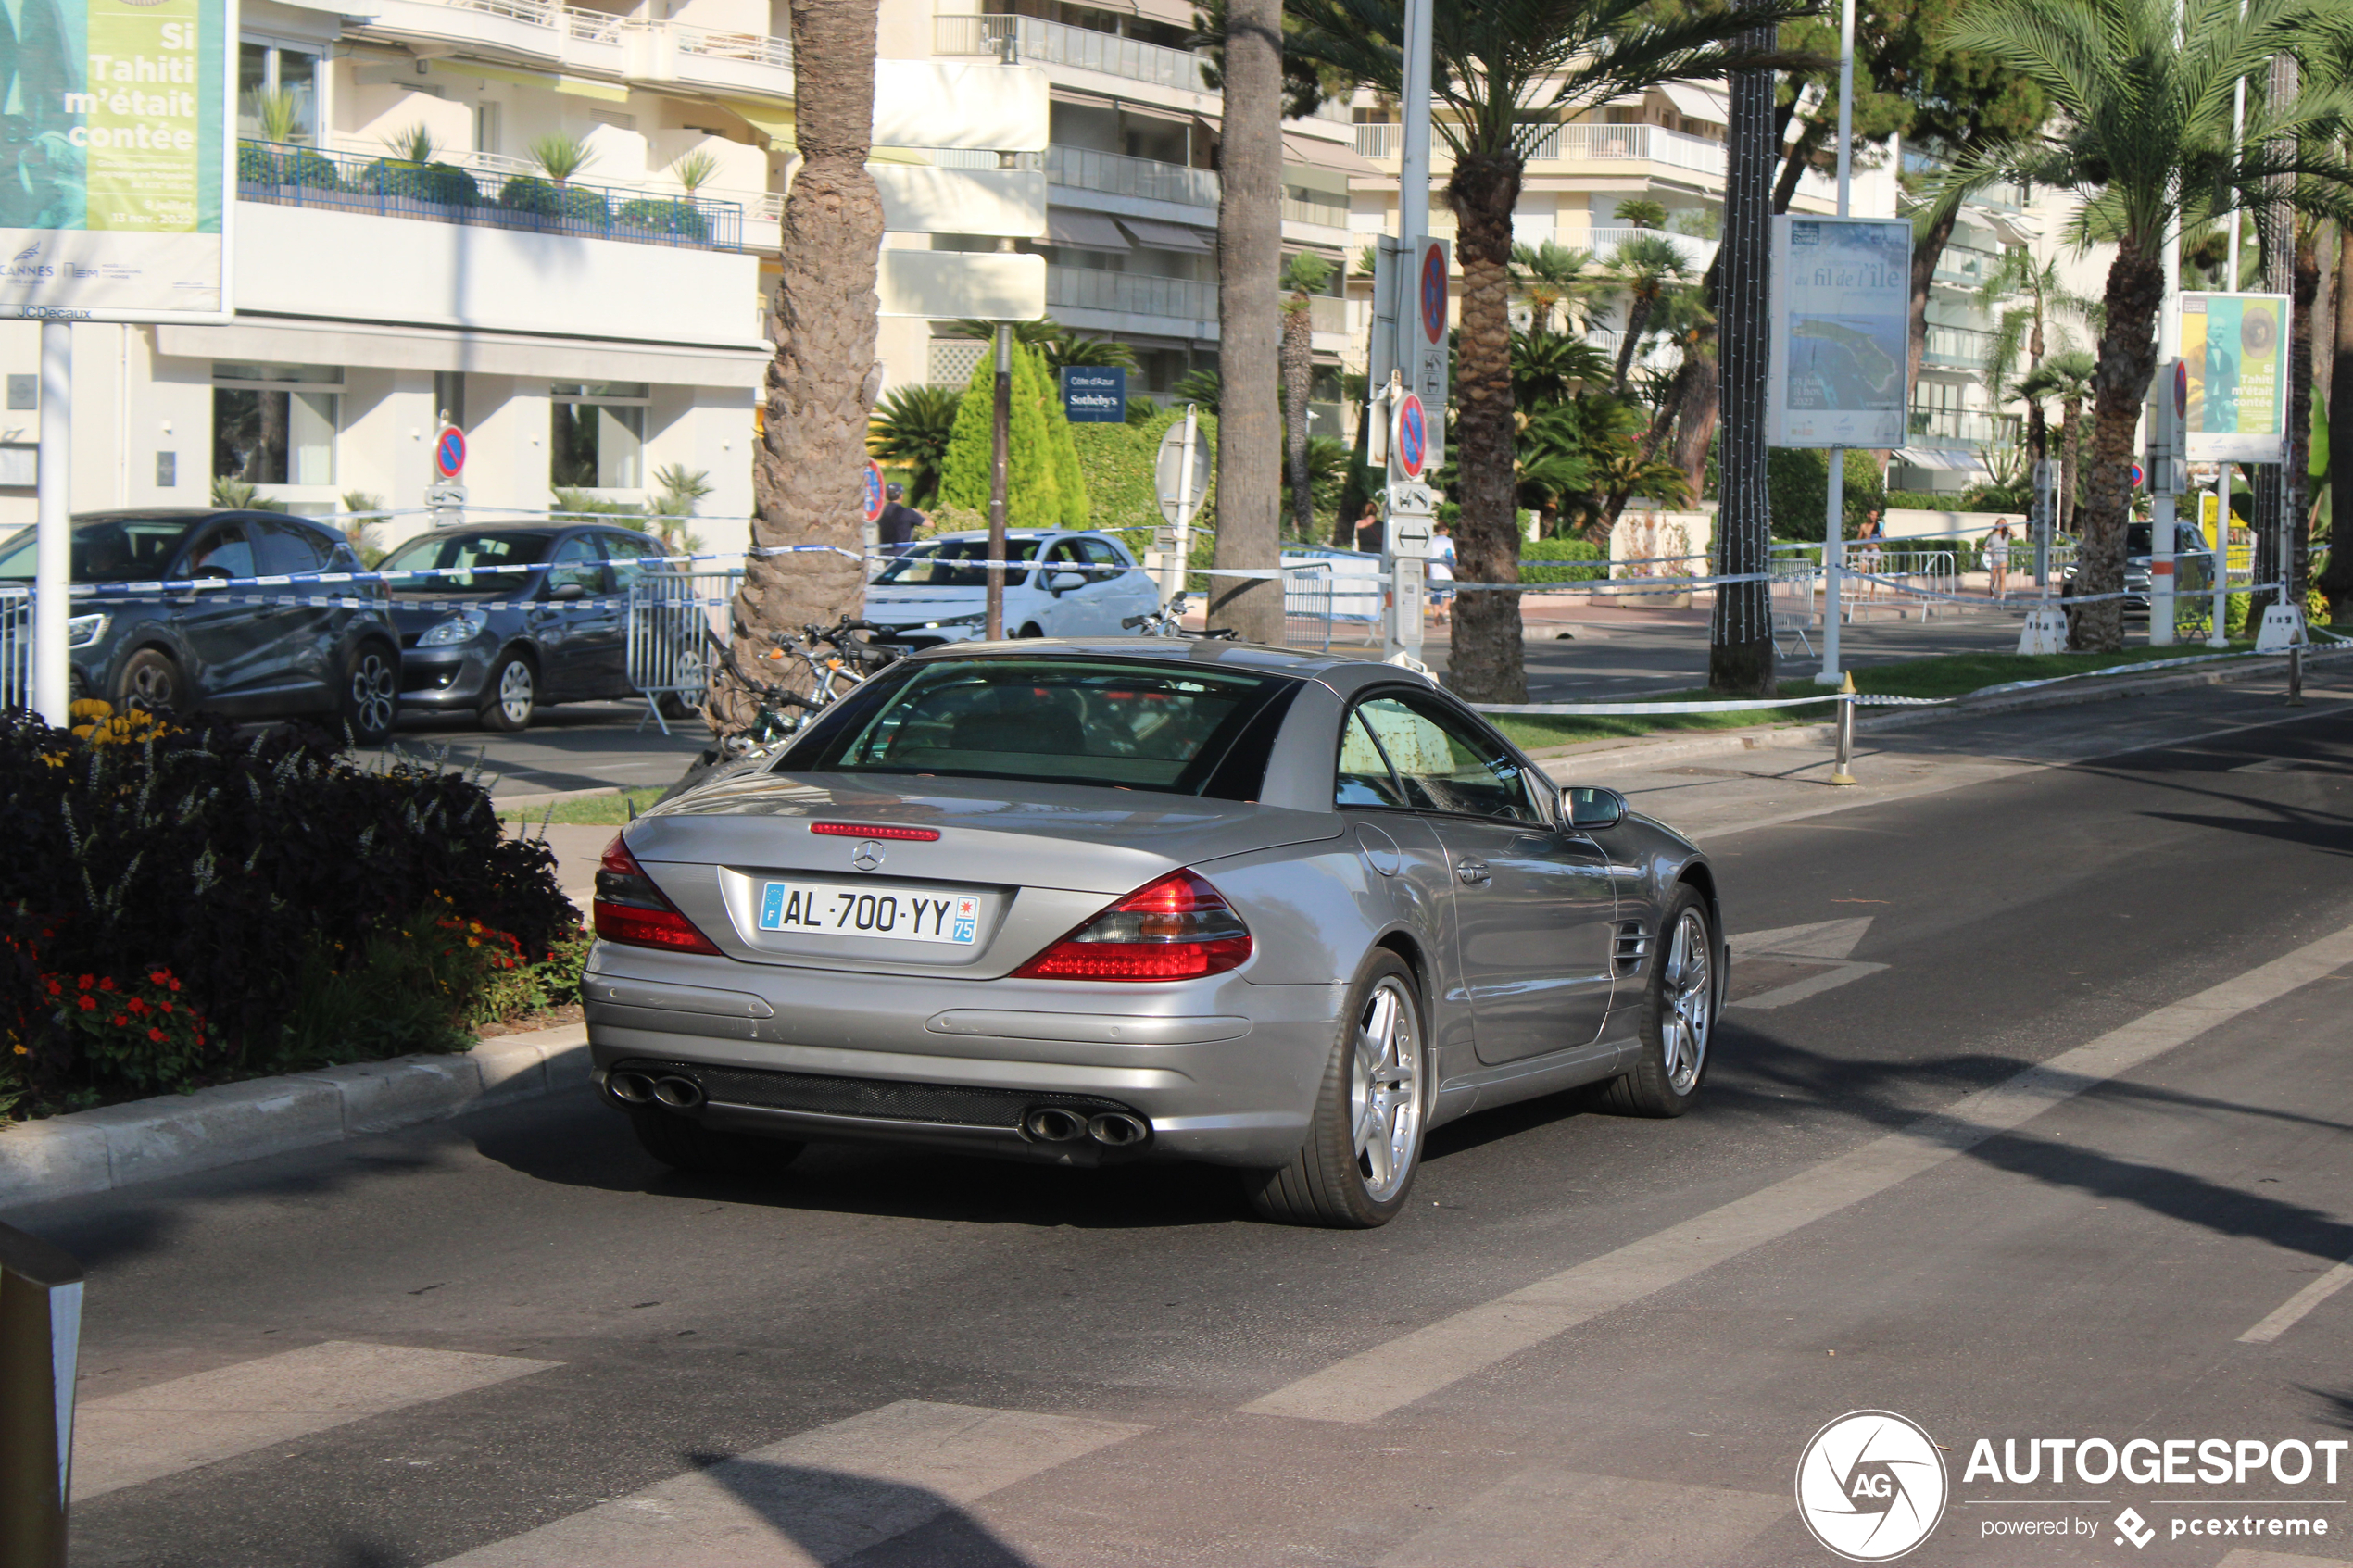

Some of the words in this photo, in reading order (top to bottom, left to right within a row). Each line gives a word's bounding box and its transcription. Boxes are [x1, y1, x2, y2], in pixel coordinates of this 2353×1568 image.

[160, 22, 194, 50] Si
[89, 54, 194, 84] Tahiti
[64, 87, 195, 117] m'était
[69, 122, 193, 151] contée
[144, 199, 153, 209] 9
[156, 199, 193, 212] juillet
[112, 212, 126, 222] 13
[129, 214, 157, 223] nov.
[159, 213, 193, 224] 2022
[1814, 268, 1832, 286] fil
[1836, 269, 1854, 286] de
[1857, 262, 1899, 288] l'île
[17, 306, 92, 319] JCDecaux
[2263, 364, 2274, 373] Si
[1070, 376, 1089, 385] Côte
[1089, 376, 1115, 386] d'Azur
[2240, 374, 2273, 384] Tahiti
[2232, 385, 2273, 395] m'était
[1070, 394, 1118, 408] Sotheby's
[1793, 397, 1814, 406] 2022
[2233, 396, 2273, 408] contée
[767, 910, 775, 921] F
[955, 921, 974, 938] 75
